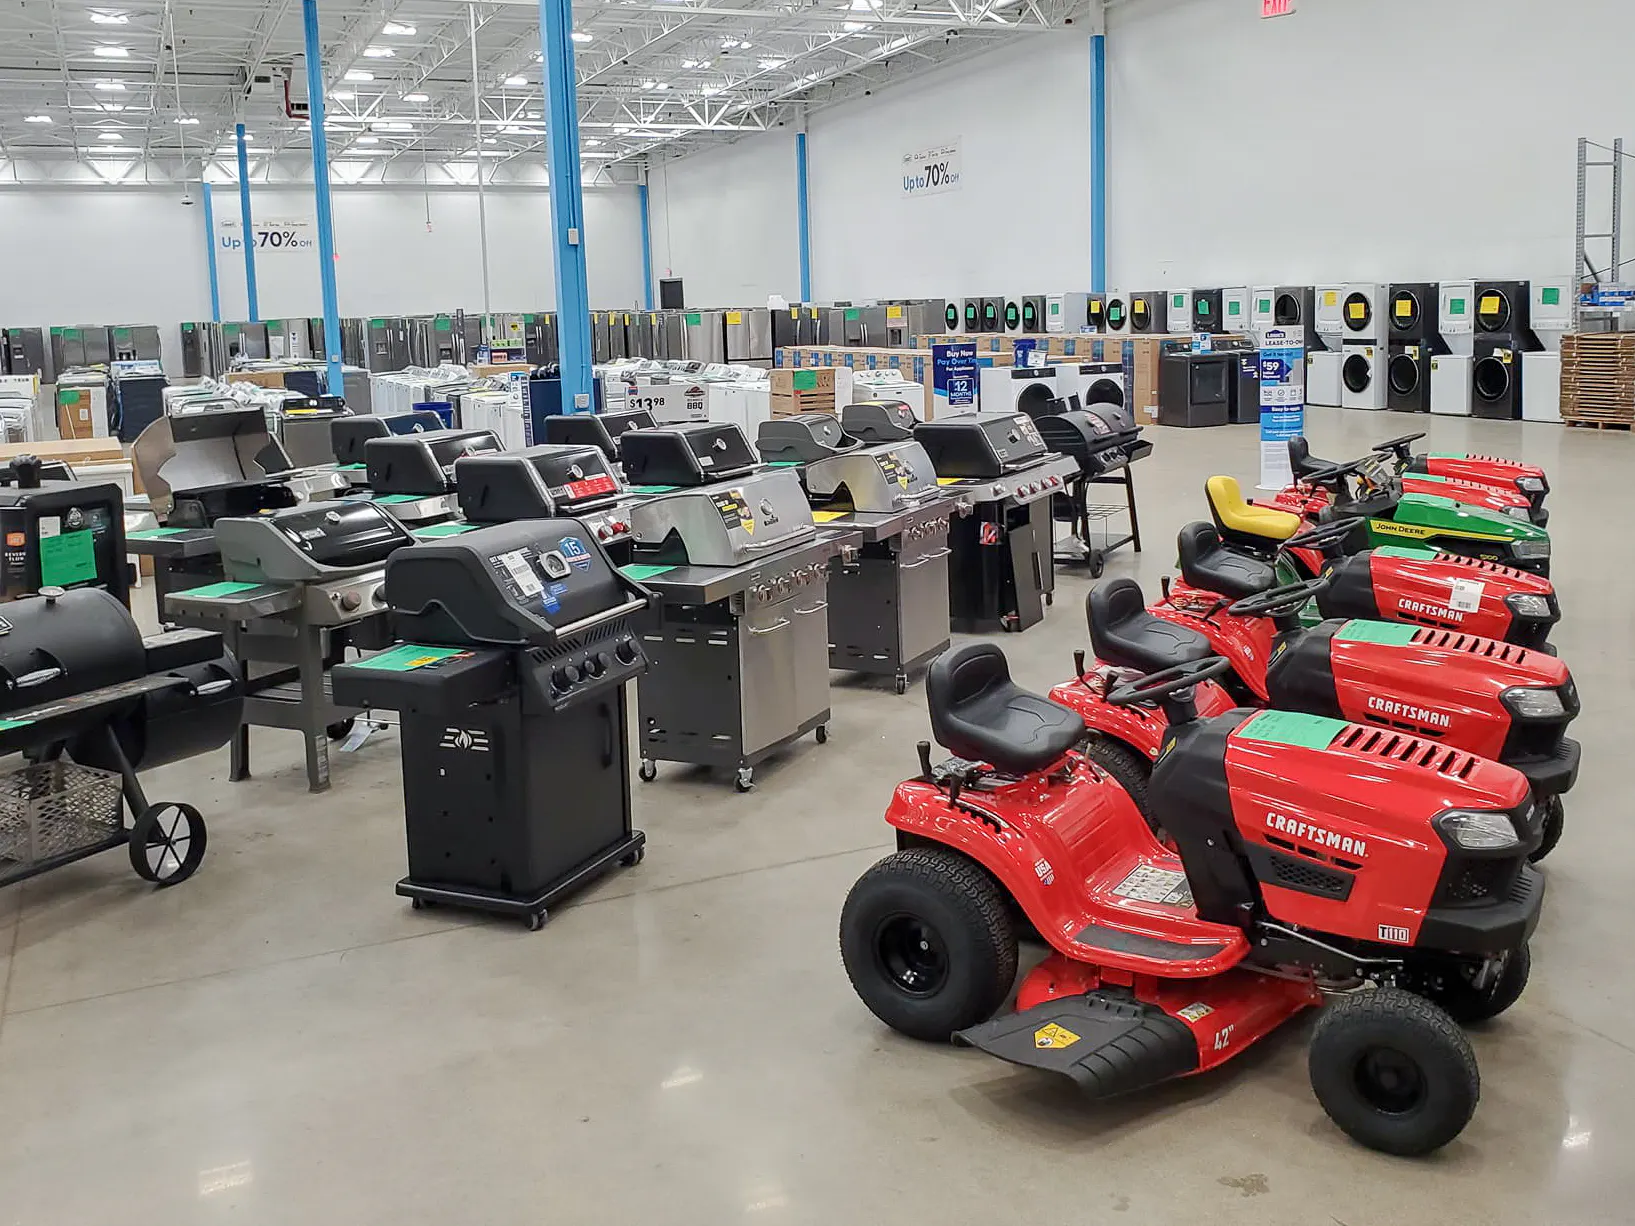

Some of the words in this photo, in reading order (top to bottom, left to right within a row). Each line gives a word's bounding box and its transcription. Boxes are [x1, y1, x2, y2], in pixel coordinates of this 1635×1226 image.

[903, 176, 915, 193] Up
[916, 175, 925, 188] to
[924, 161, 949, 188] 70%
[221, 236, 241, 250] Up
[257, 231, 298, 248] 70%
[946, 350, 960, 358] Buy
[1262, 360, 1280, 371] $59
[955, 380, 968, 392] 12
[687, 402, 703, 410] BBQ
[1376, 523, 1397, 532] JOHN
[1398, 525, 1426, 535] DEERE
[564, 541, 580, 556] 15
[1398, 598, 1463, 622] CRAFTSMAN
[1367, 696, 1450, 727] CRAFTSMAN
[1266, 812, 1367, 857] CRAFTSMAN
[1379, 926, 1407, 941] T110
[1214, 1024, 1234, 1050] 42"
